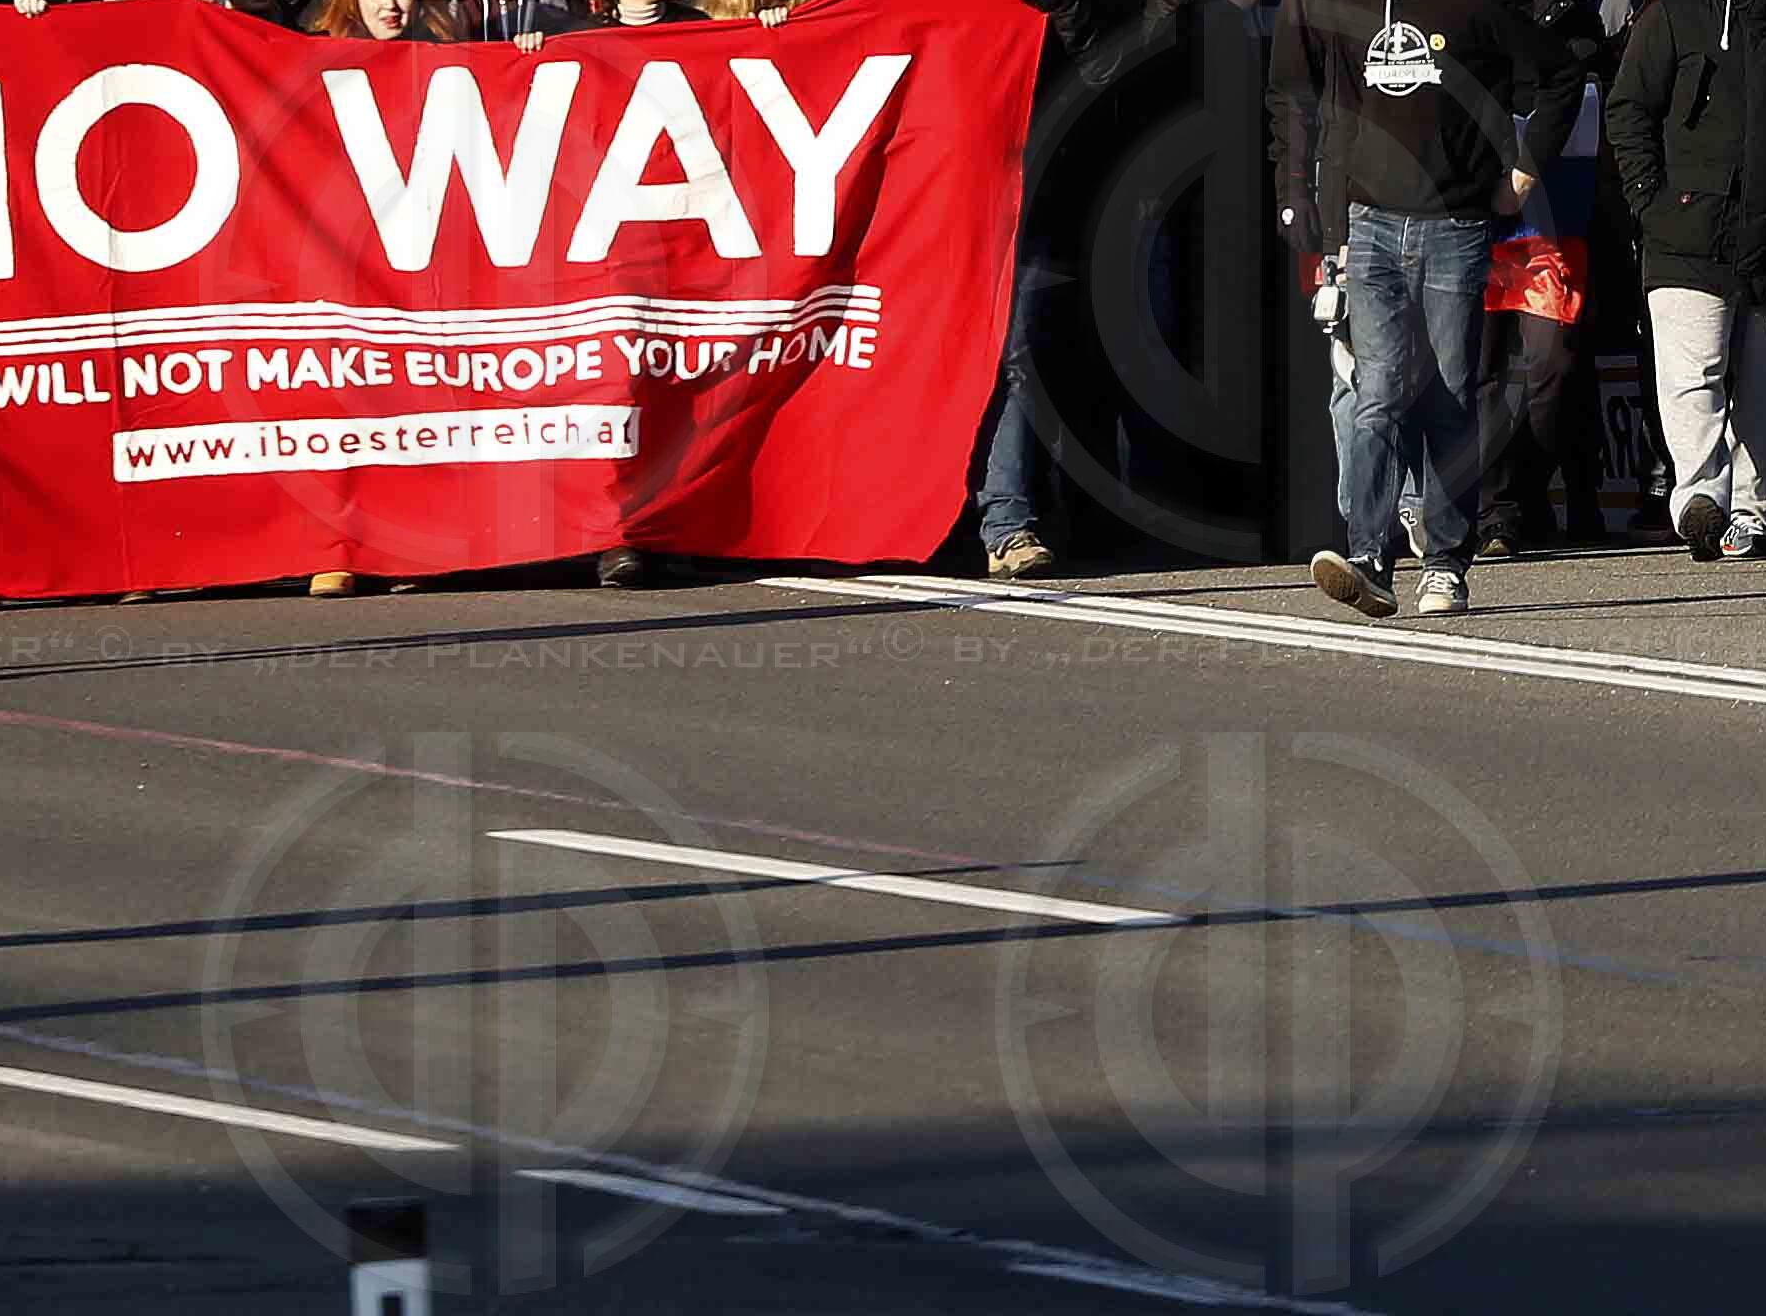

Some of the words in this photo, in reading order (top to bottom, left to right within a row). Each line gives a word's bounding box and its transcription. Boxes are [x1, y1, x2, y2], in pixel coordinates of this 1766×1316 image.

[321, 53, 912, 273] WAY
[123, 348, 233, 398] NOT
[245, 343, 394, 393] MAKE
[406, 341, 602, 394] EUROPE
[613, 335, 738, 381] YOUR
[747, 325, 878, 376] HOME
[127, 409, 634, 470] www.iboesterreich.at
